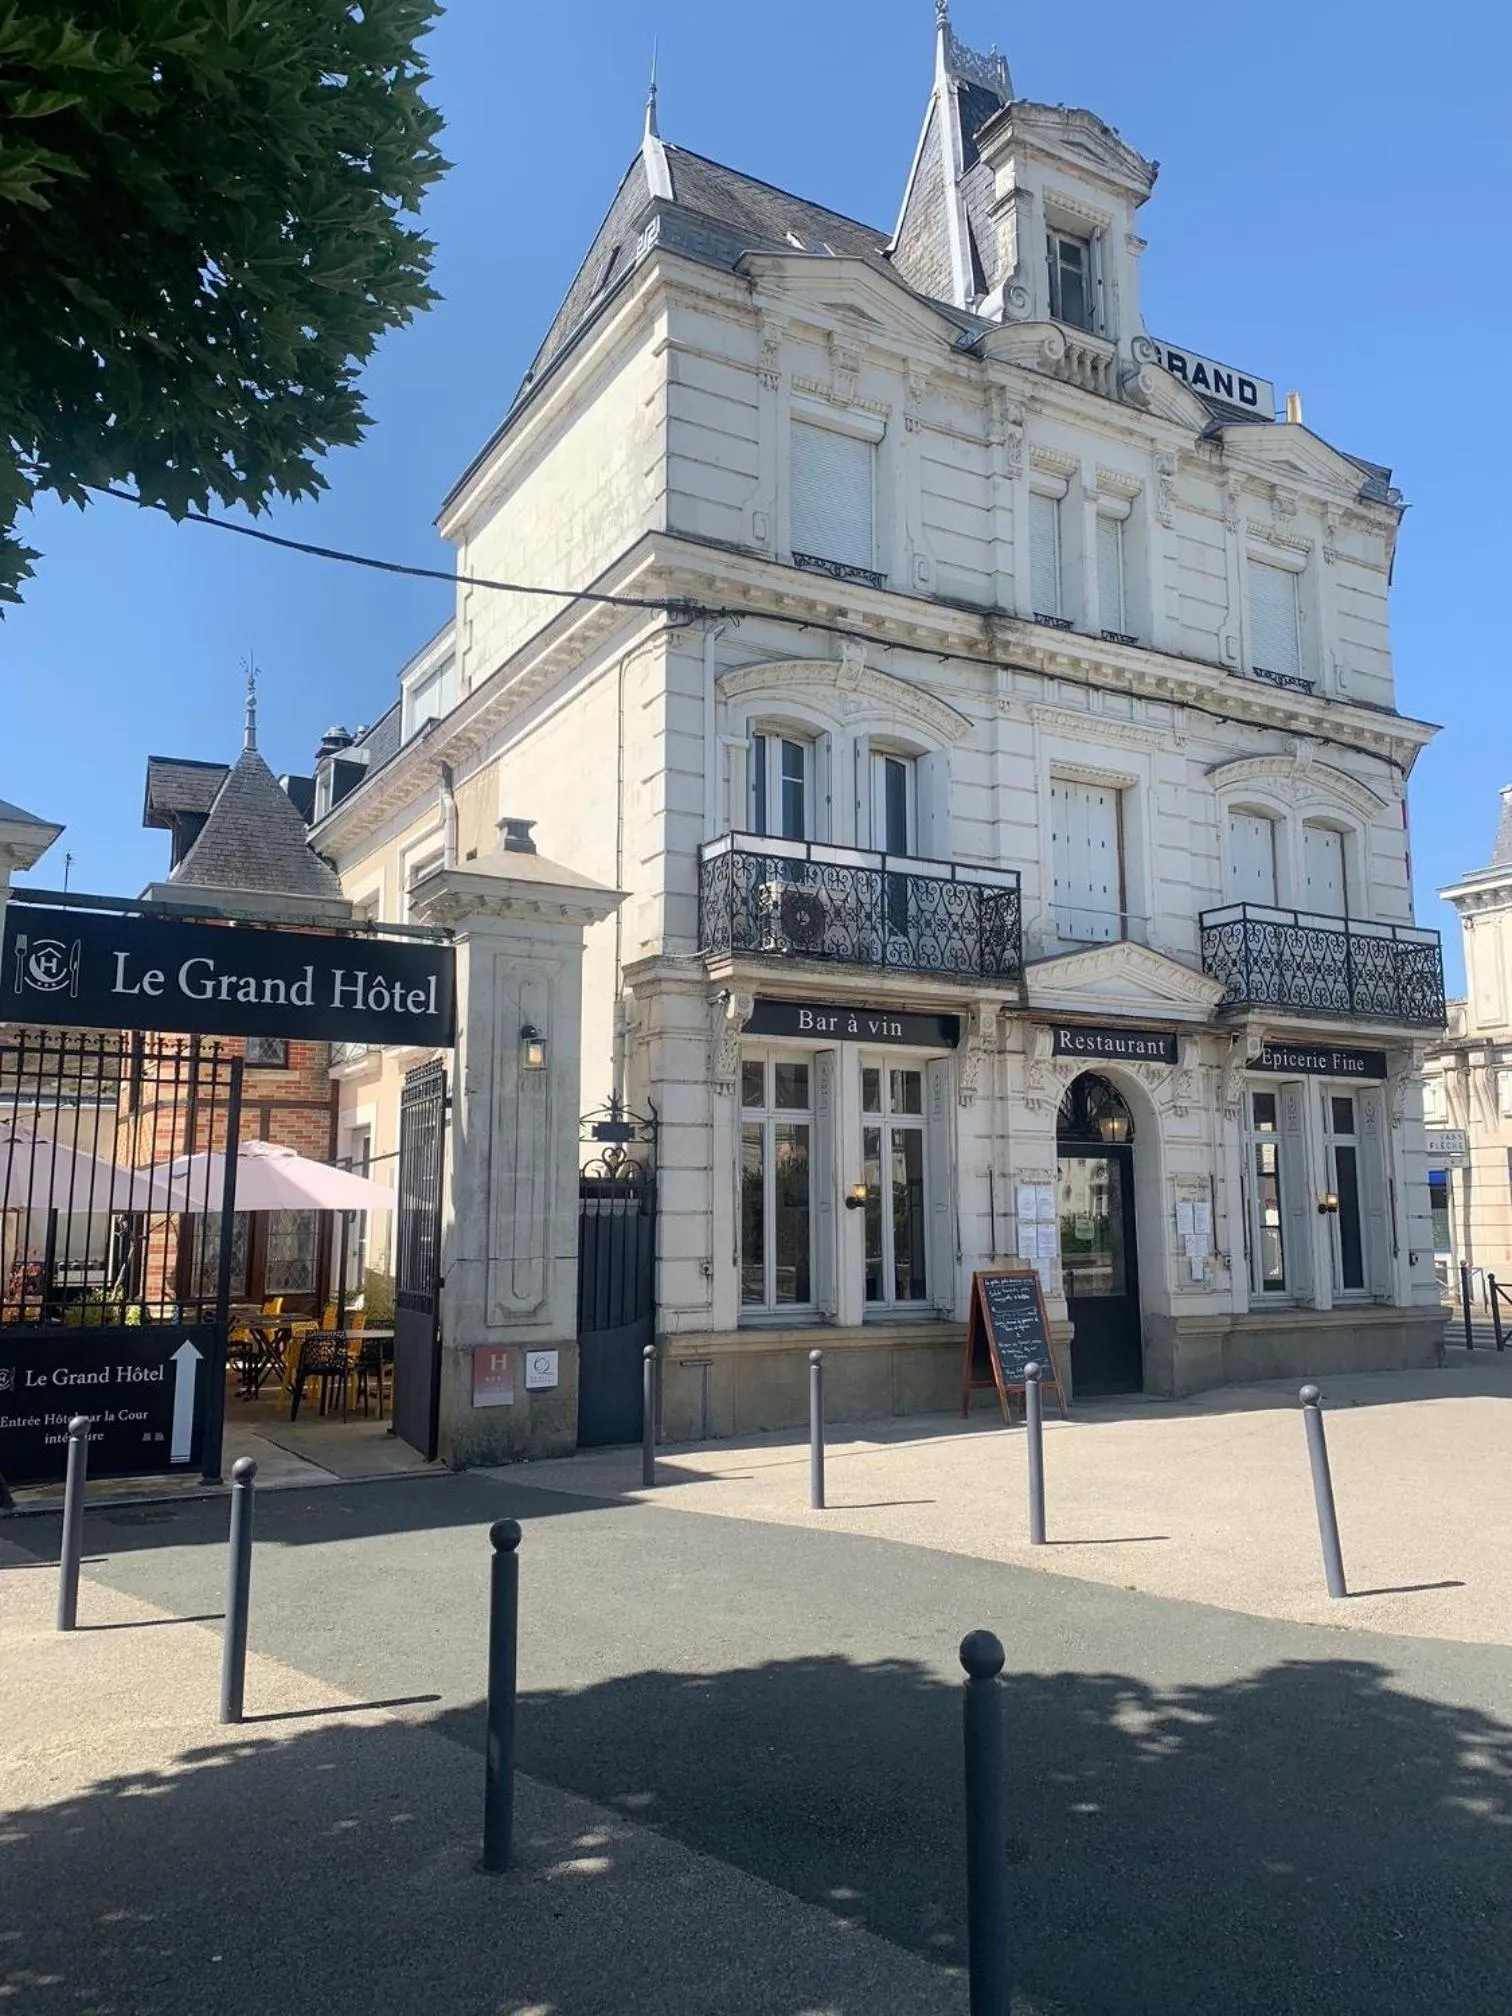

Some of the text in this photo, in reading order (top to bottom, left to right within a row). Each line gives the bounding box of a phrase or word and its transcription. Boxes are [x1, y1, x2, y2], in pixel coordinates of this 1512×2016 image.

[1156, 345, 1258, 406] RAND
[111, 951, 439, 1014] Le Grand Hôtel
[798, 1009, 902, 1036] Bar à vin
[1059, 1030, 1166, 1055] Restaurant
[1262, 1047, 1365, 1071] Epicerie Fine
[491, 1353, 507, 1371] H
[25, 1364, 164, 1387] Le Grand Hôtel
[0, 1415, 41, 1428] Entrée
[105, 1410, 116, 1422] la
[118, 1409, 148, 1420] Cour
